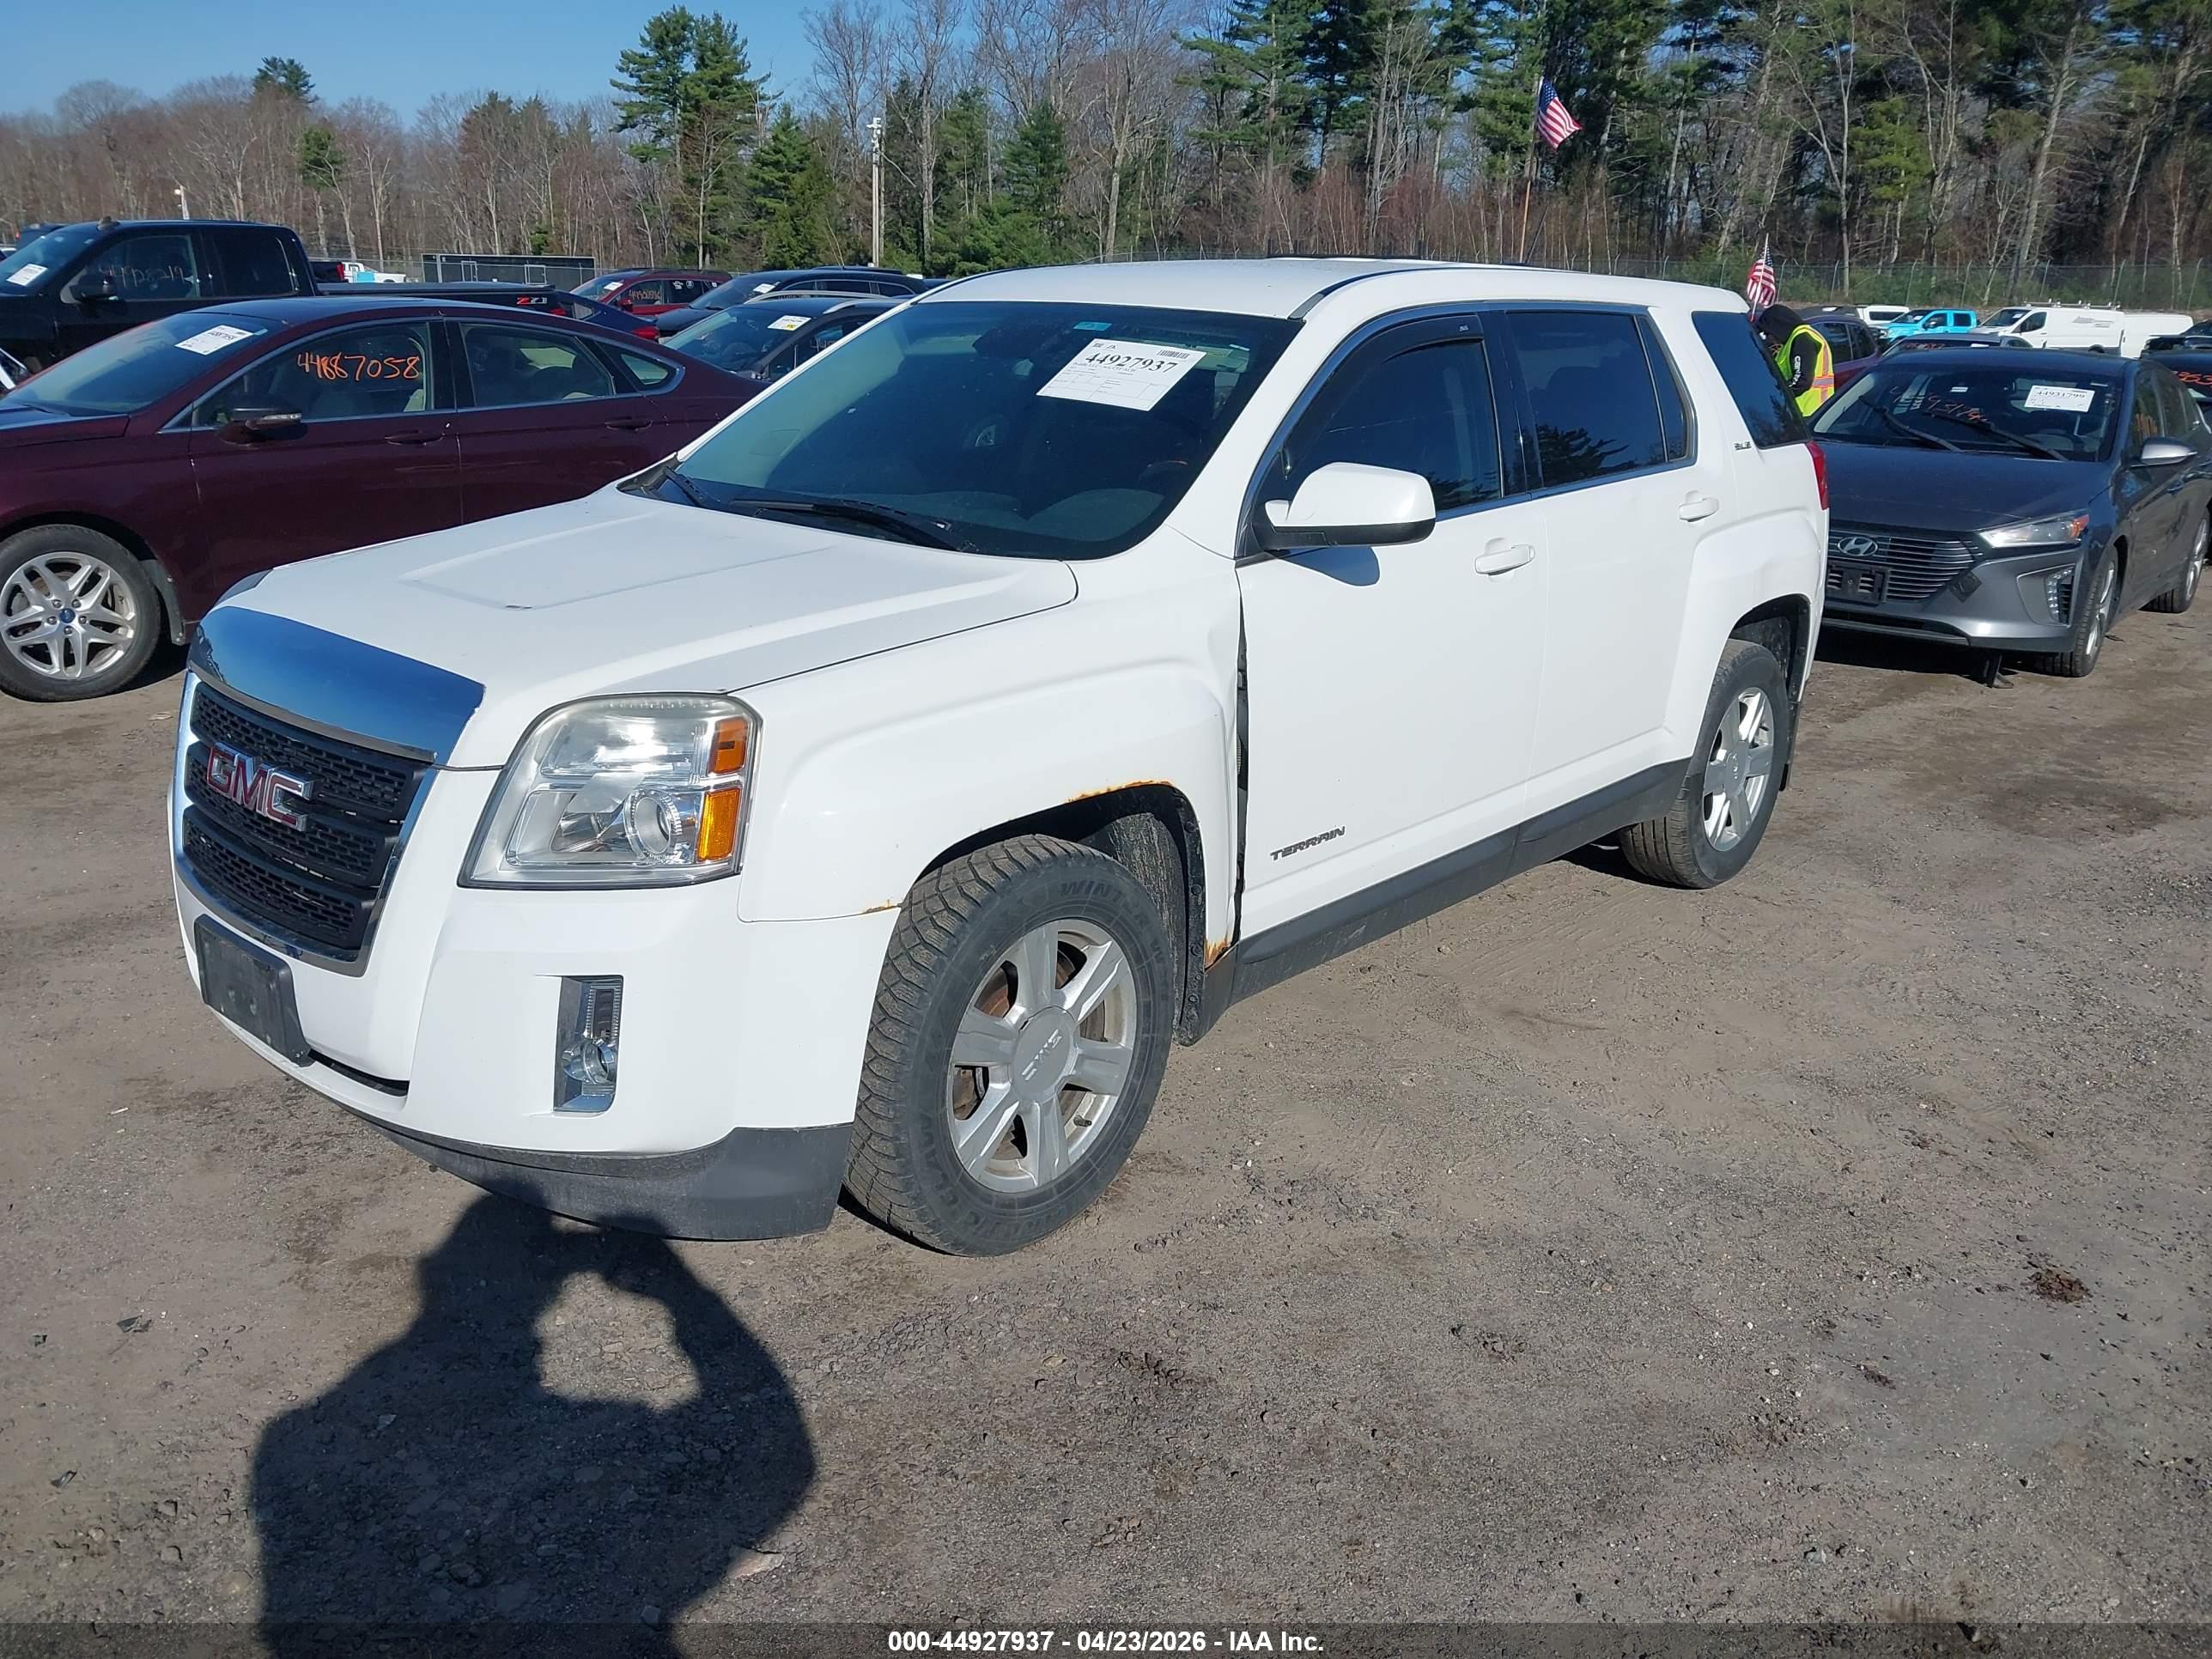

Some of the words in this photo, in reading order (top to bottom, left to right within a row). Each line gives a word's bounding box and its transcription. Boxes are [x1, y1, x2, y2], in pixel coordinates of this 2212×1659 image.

[297, 352, 420, 381] 44887058
[1085, 352, 1178, 374] 44927937
[207, 742, 313, 832] GMC
[1270, 826, 1346, 861] TERRAIN
